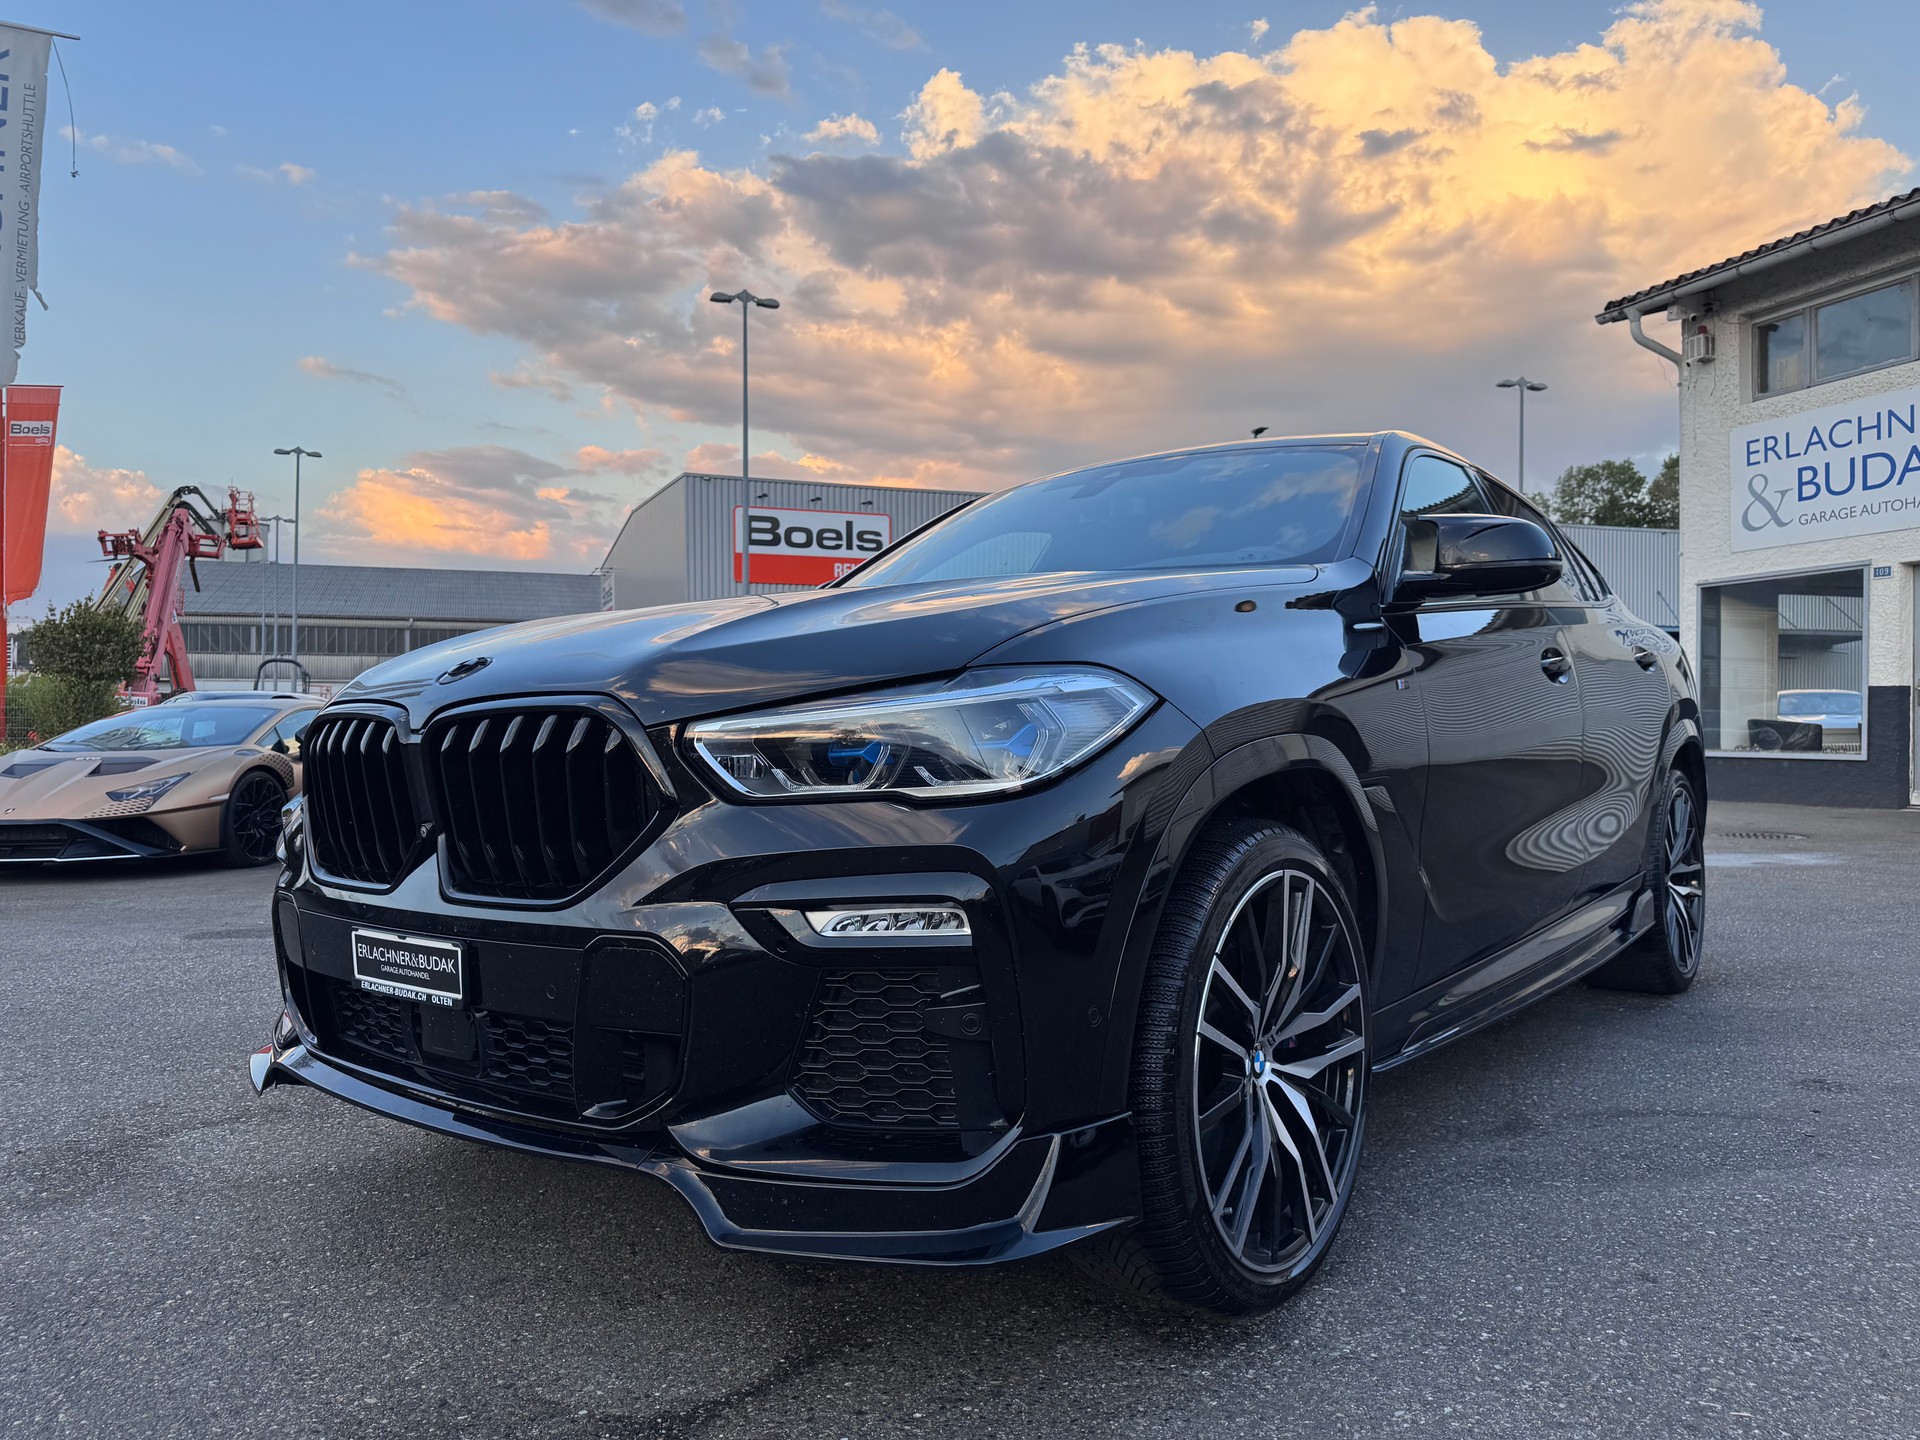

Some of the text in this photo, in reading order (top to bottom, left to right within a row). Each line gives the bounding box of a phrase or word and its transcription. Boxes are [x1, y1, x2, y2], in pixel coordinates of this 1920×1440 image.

[14, 83, 36, 349] VERKAUF VERMIETUNG AIRPORTSHUTTLE
[10, 423, 50, 435] Boels
[1746, 404, 1915, 467] ERLACHN
[1741, 473, 1794, 532] &
[1798, 505, 1857, 526] GARAGE
[748, 515, 883, 553] Boels
[1876, 567, 1889, 576] 109
[357, 943, 456, 974] ERLACHNER&BUDAK
[380, 964, 431, 980] GARAGE AUTOHANDEL
[361, 980, 453, 1007] ERLACHNER-BUDAK.CH OLTEN
